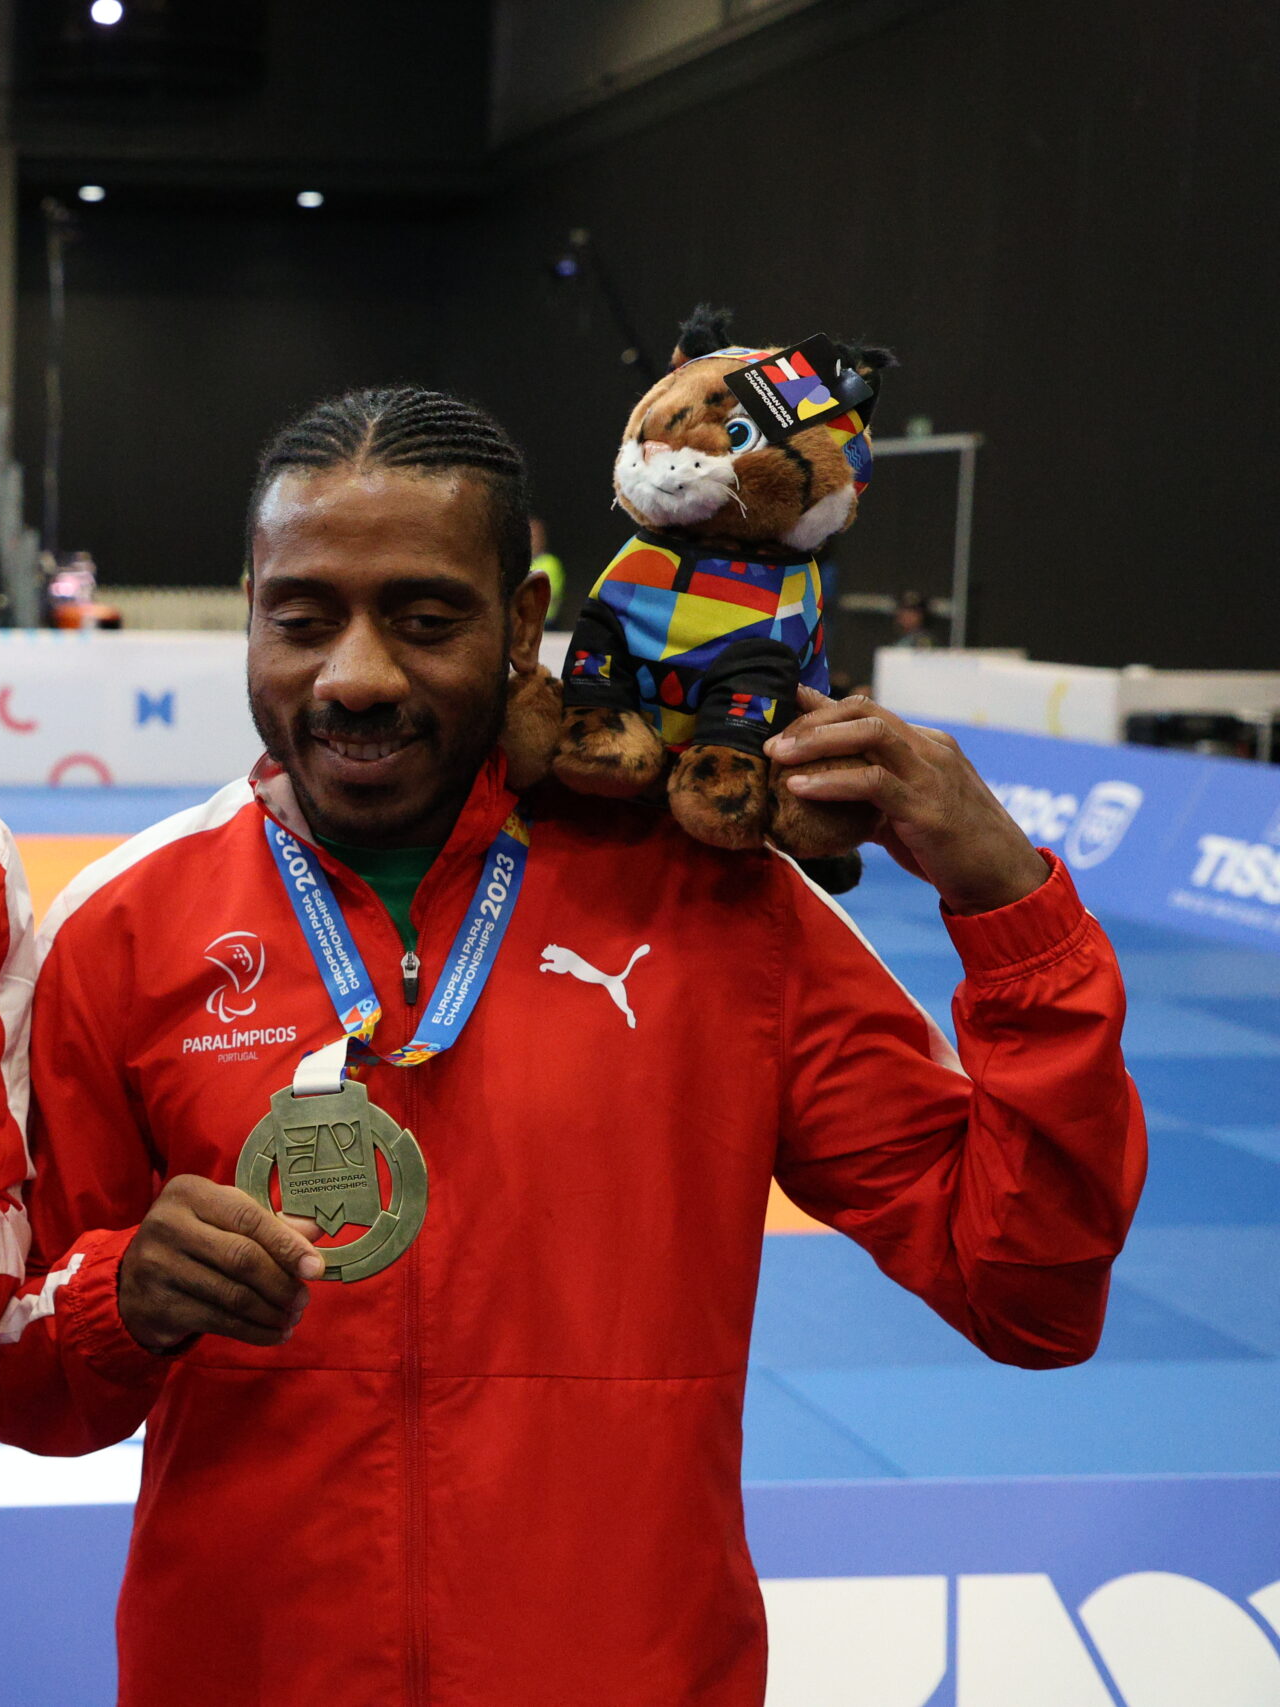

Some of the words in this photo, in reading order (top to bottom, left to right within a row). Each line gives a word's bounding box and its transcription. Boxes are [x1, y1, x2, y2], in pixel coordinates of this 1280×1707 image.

[744, 372, 789, 429] CHAMPIONSHIPS
[750, 369, 781, 407] EUROPEAN
[778, 403, 794, 426] PARA
[302, 894, 321, 932] PARA
[480, 852, 515, 920] 2023
[312, 888, 360, 990] CHAMPIONSHIPS
[315, 929, 350, 996] EUROPEAN
[431, 954, 470, 1024] EUROPEAN
[462, 917, 484, 955] PARA
[443, 921, 495, 1026] CHAMPIONSHIPS
[182, 1025, 297, 1054] PARALÍMPICOS
[218, 1051, 258, 1064] PORTUGAL
[289, 1176, 340, 1188] EUROPEAN
[341, 1173, 367, 1183] PARA
[290, 1181, 368, 1196] CHAMPIONSHIPS
